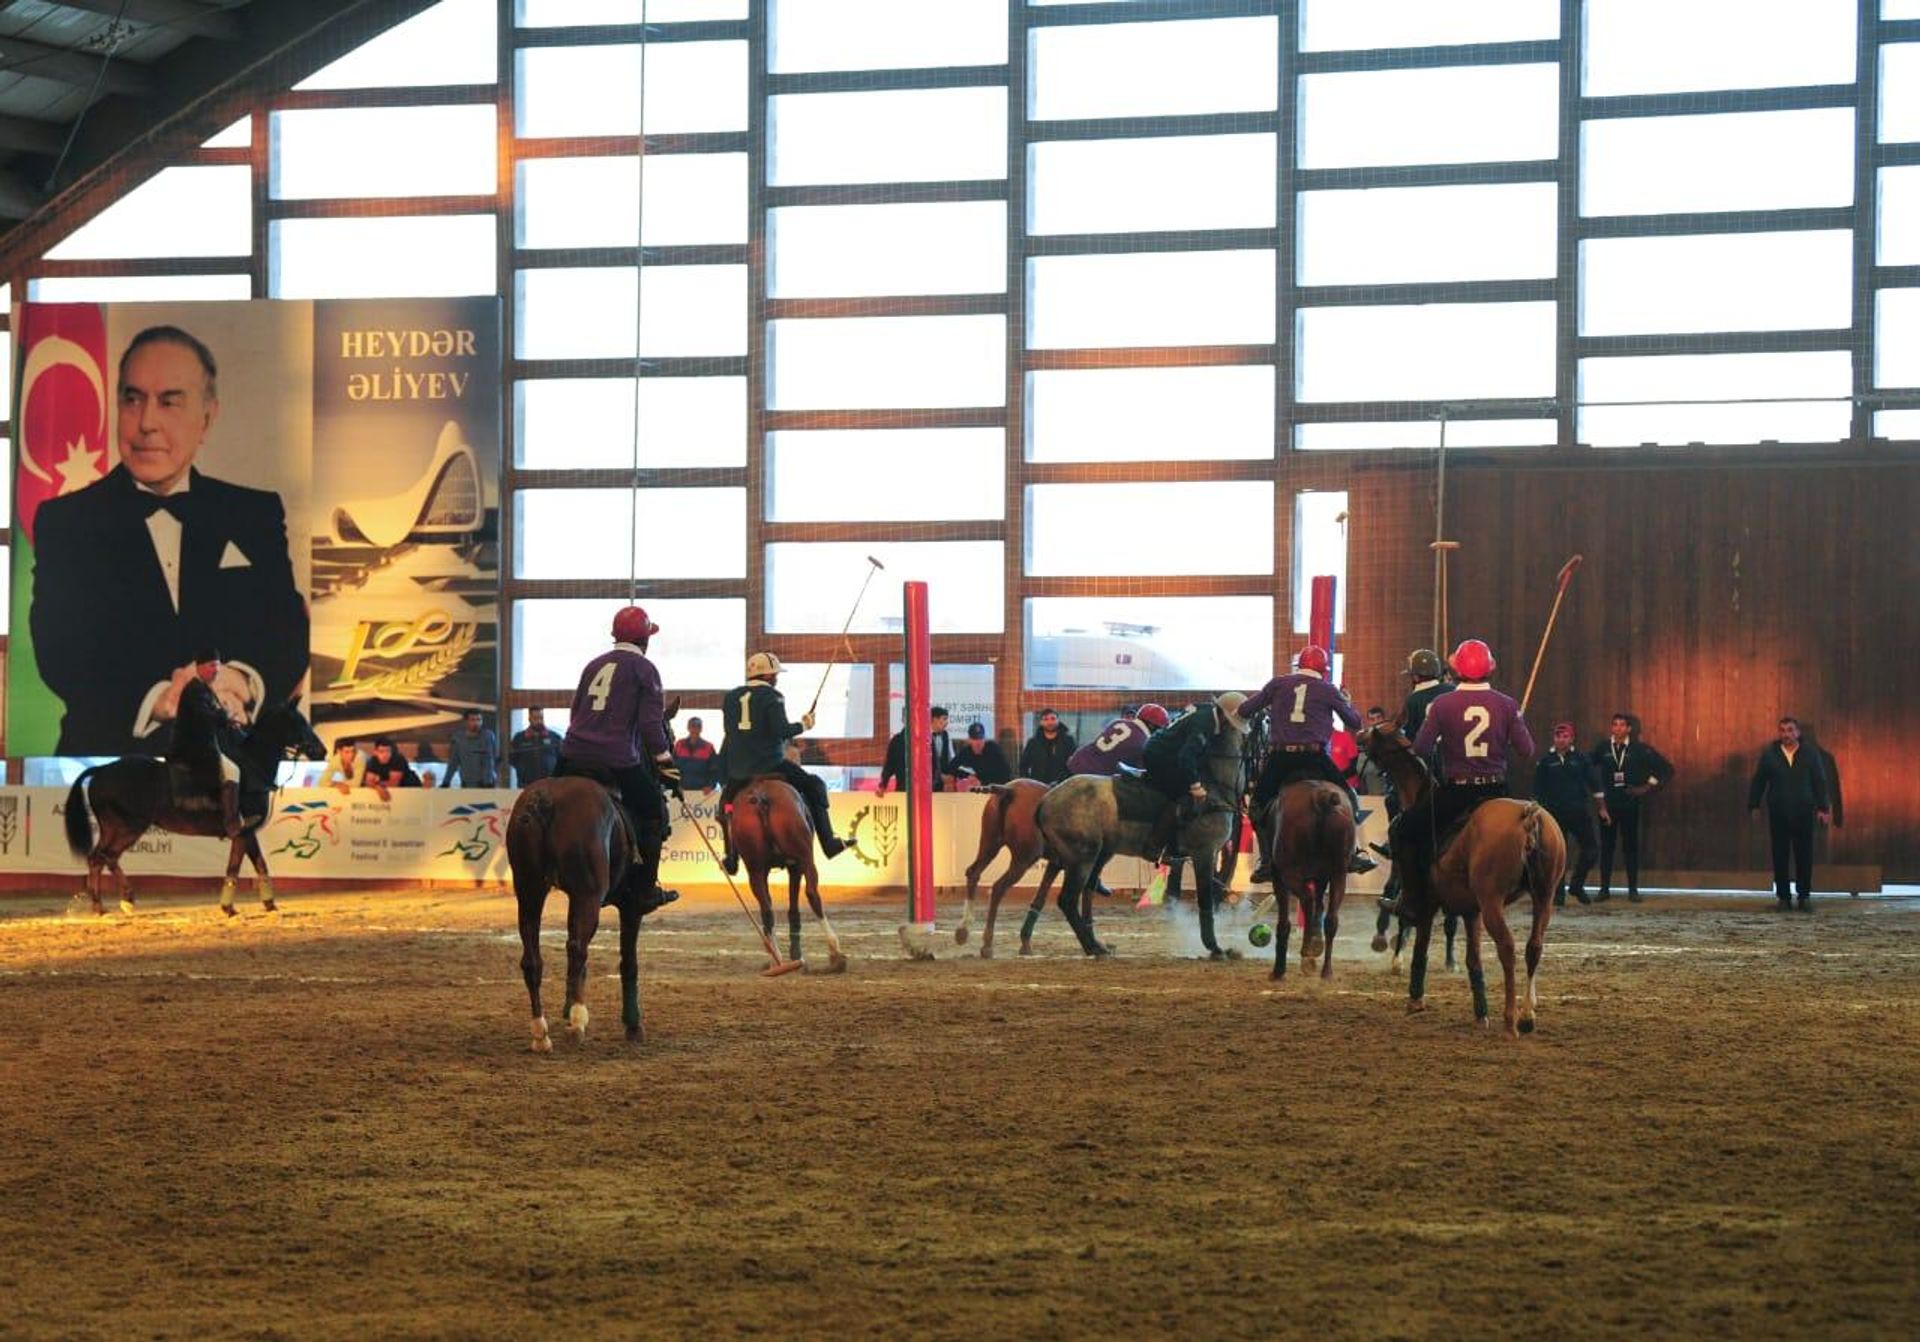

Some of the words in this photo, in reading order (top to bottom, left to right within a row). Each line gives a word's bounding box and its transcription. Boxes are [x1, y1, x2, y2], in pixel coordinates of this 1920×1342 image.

[340, 330, 477, 358] HEYDƏR
[347, 367, 469, 401] ƏLİYEV
[587, 662, 618, 711] 4
[1290, 684, 1308, 723] 1
[738, 691, 752, 730] 1
[1096, 722, 1132, 752] 3
[1463, 706, 1491, 757] 2
